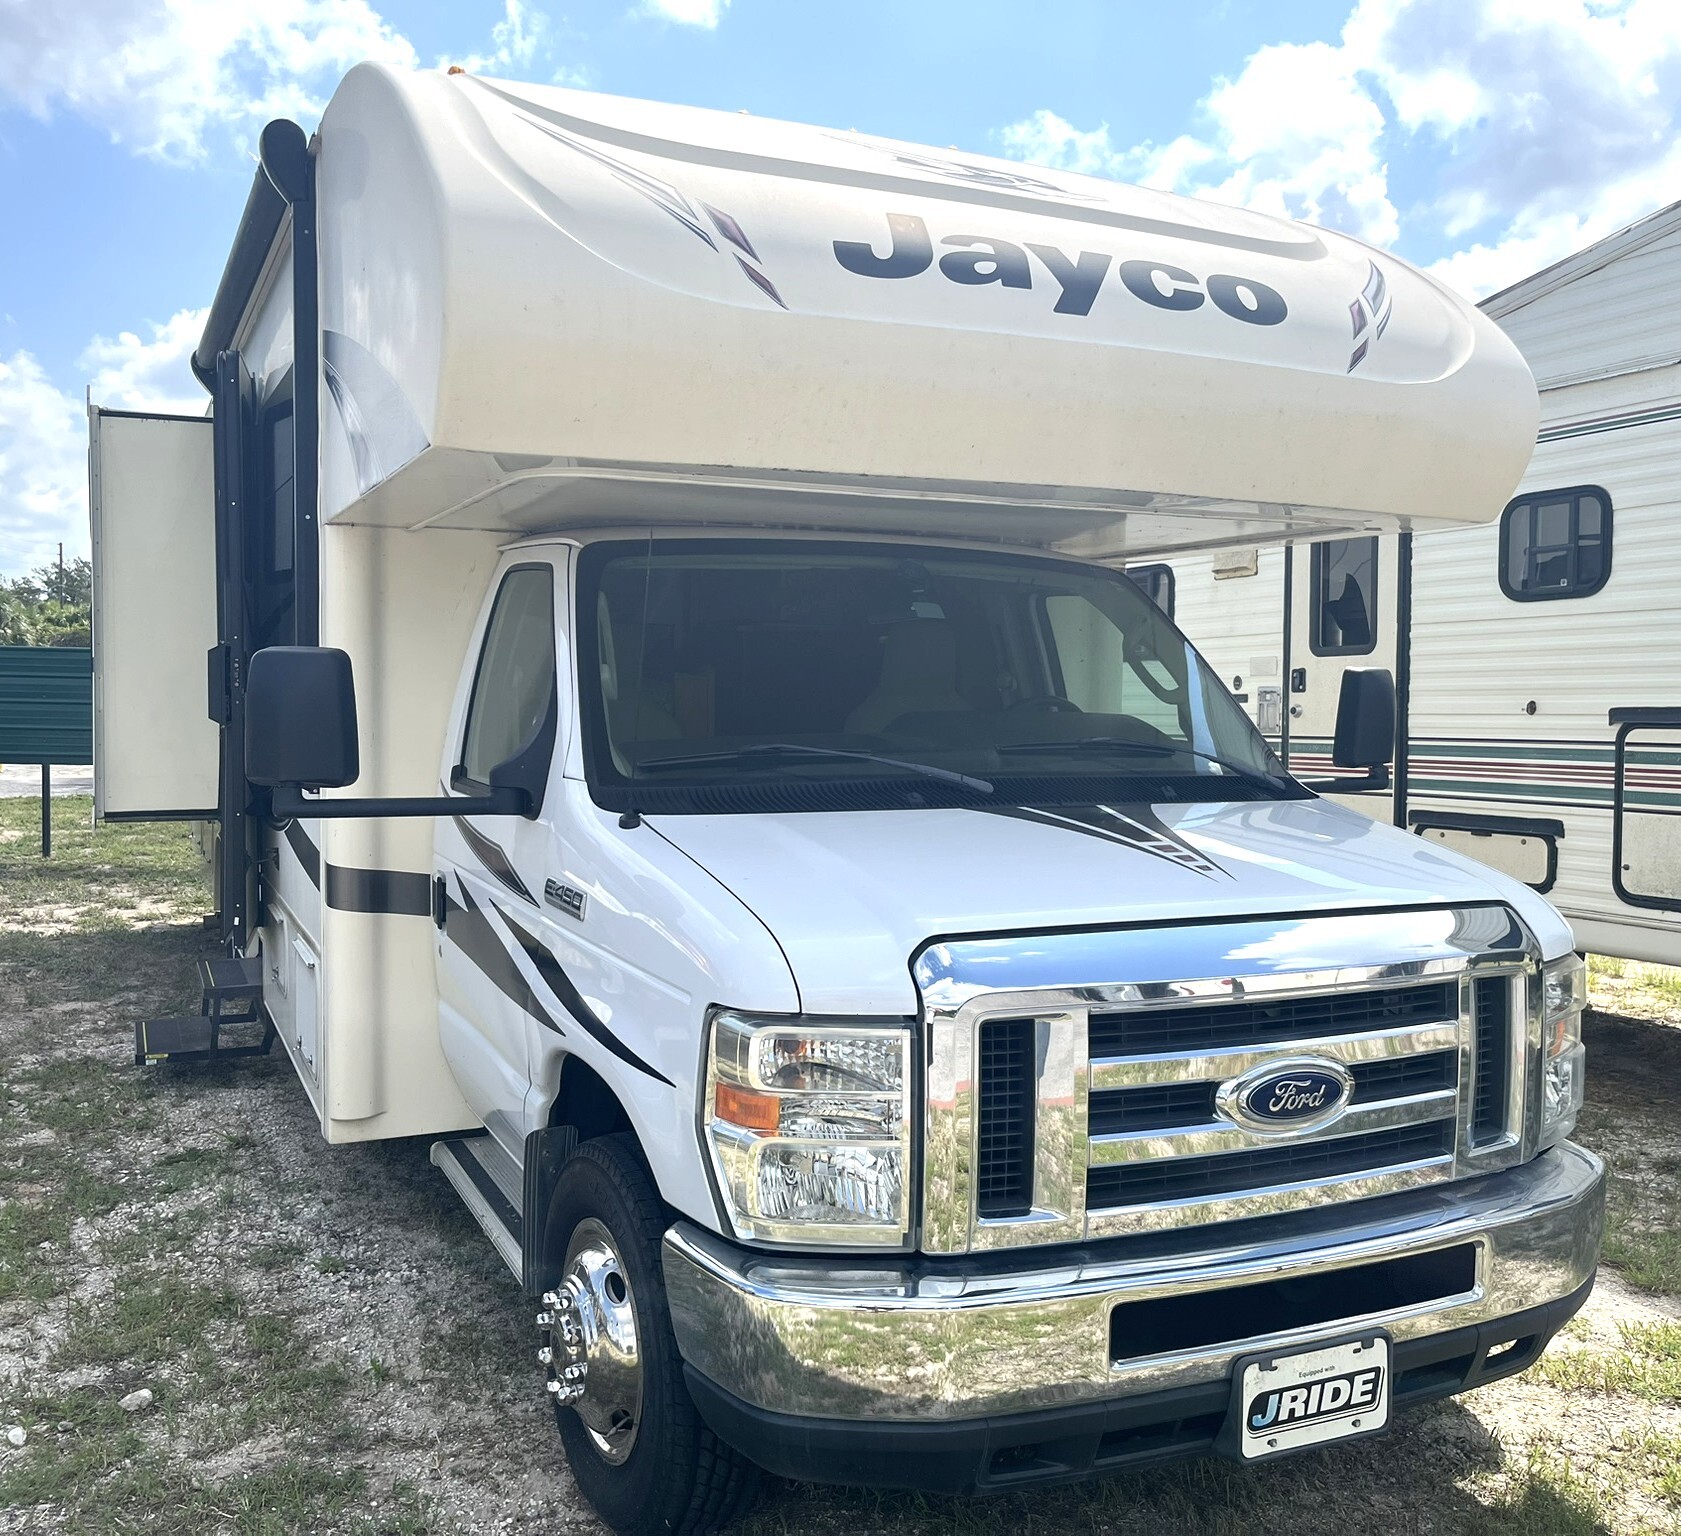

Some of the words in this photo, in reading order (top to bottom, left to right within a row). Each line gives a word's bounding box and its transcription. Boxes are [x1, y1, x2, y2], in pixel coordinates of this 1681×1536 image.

[833, 212, 1289, 327] Jayco
[1268, 1080, 1326, 1112] Ford
[1298, 1368, 1324, 1378] Equipped
[1252, 1371, 1376, 1427] JRIDE
